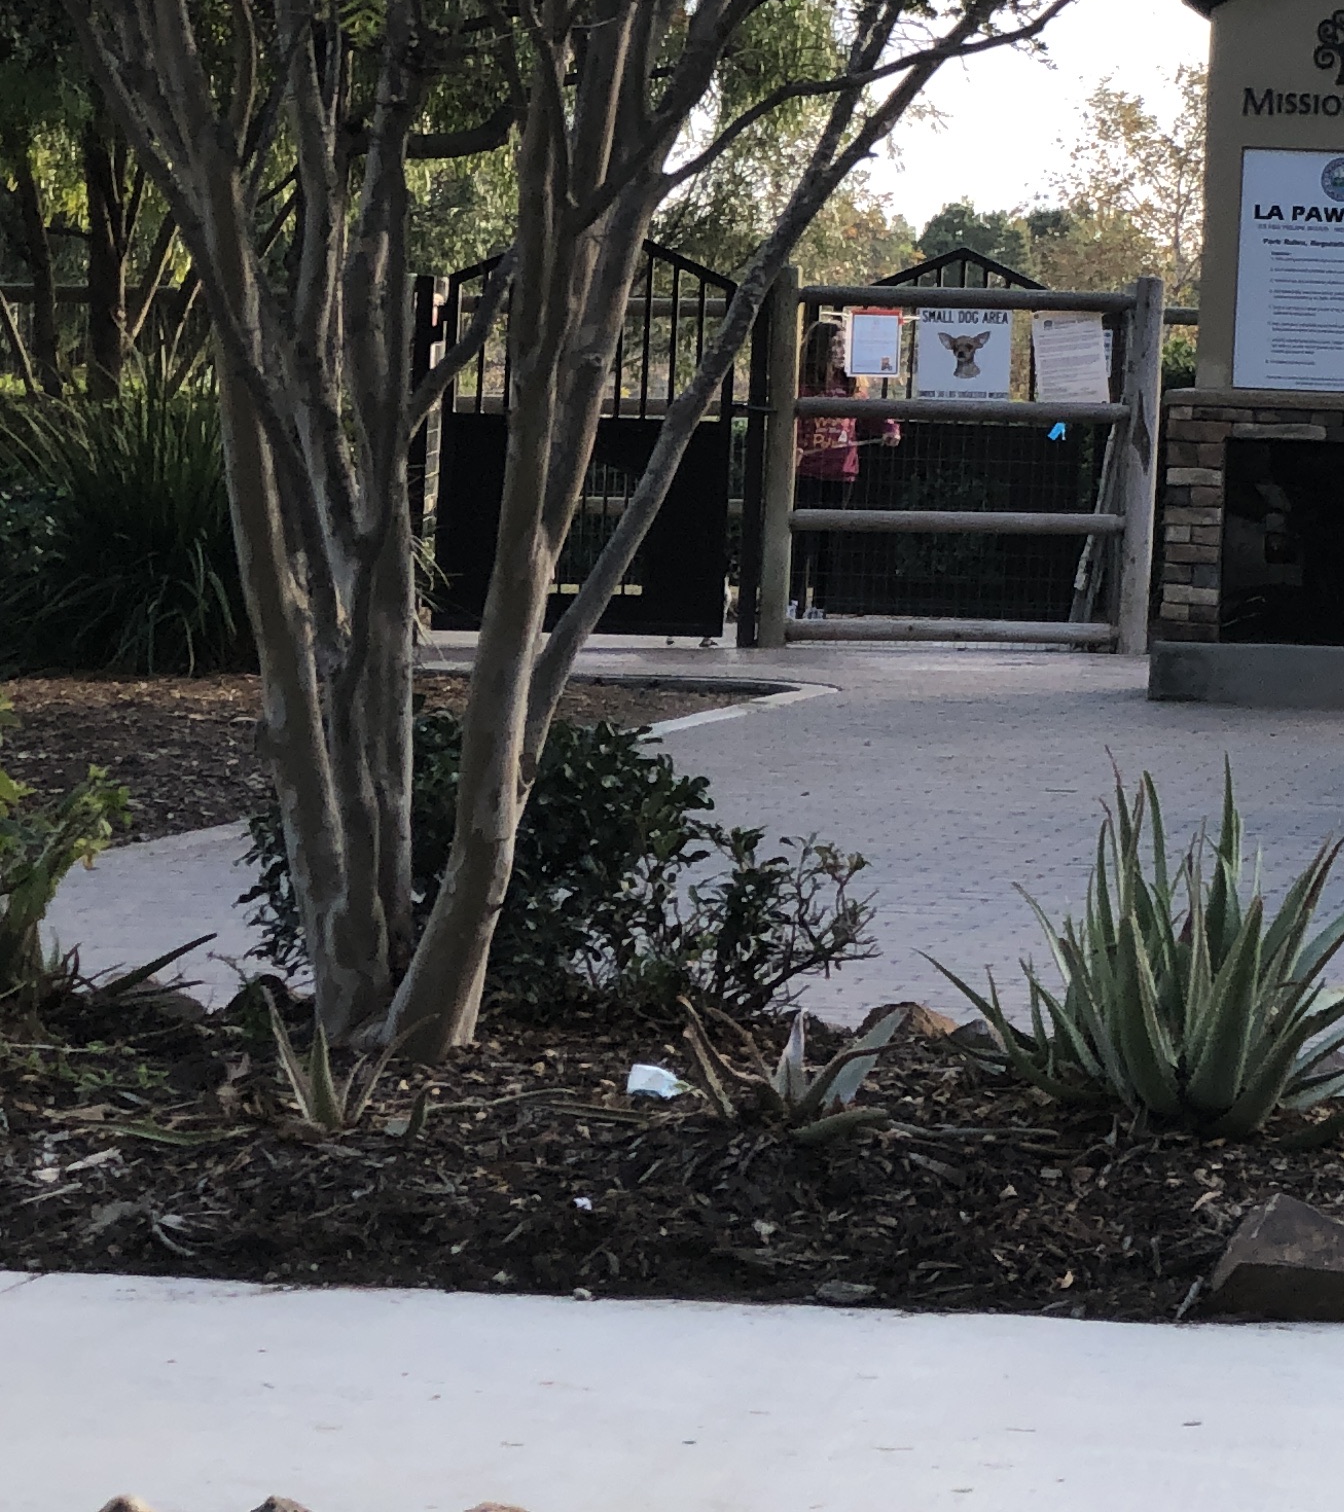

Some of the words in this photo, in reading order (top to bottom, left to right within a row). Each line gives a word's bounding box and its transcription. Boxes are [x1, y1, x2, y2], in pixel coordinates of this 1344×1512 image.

[1253, 204, 1285, 221] LA
[922, 310, 954, 324] SMALL
[958, 310, 979, 325] DOG
[982, 311, 1009, 325] AREA
